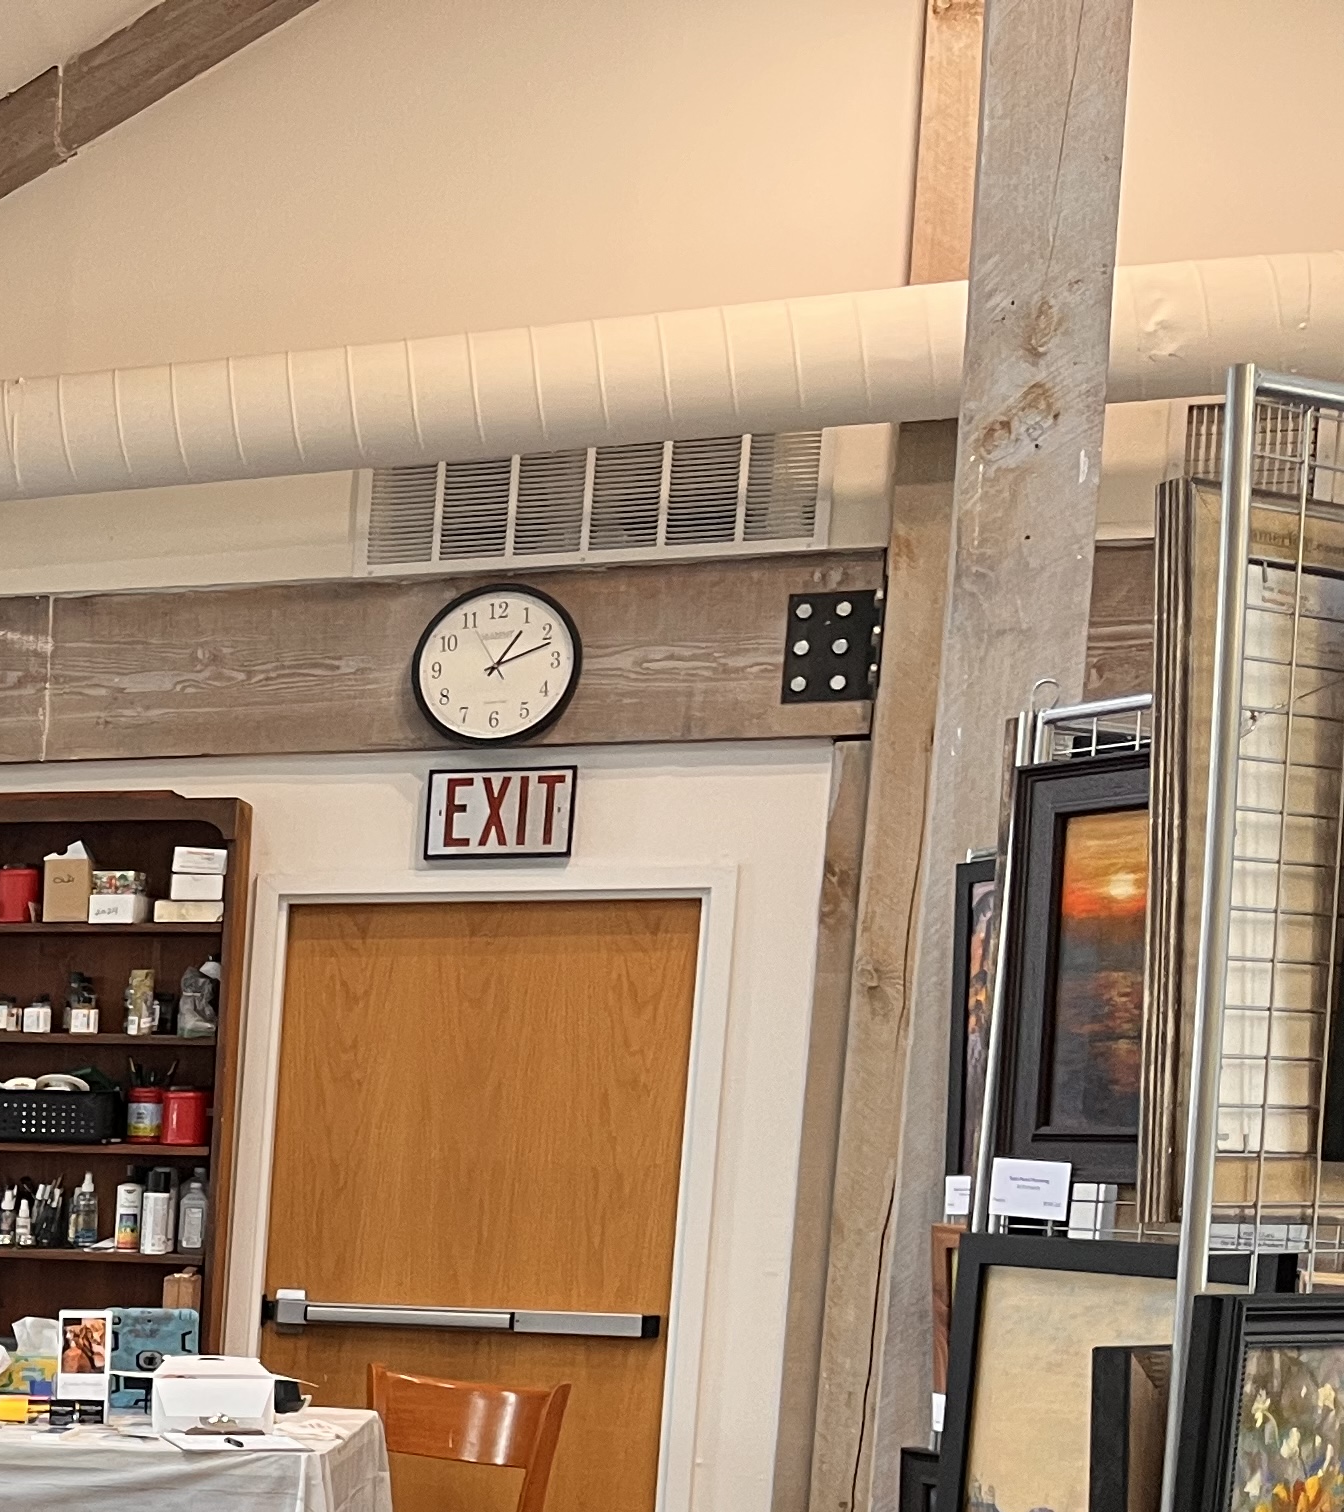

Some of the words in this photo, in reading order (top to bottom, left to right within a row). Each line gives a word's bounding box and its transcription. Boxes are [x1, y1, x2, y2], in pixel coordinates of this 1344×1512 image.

[489, 601, 509, 620] 12
[523, 607, 531, 624] 1
[462, 612, 478, 630] 11
[542, 623, 553, 641] 2
[440, 634, 458, 653] 10
[551, 651, 561, 669] 3
[431, 661, 442, 679] 9
[439, 688, 450, 706] 8
[539, 680, 550, 698] 4
[459, 706, 469, 724] 7
[488, 711, 499, 728] 6
[519, 701, 530, 720] 5
[443, 774, 566, 848] EXIT
